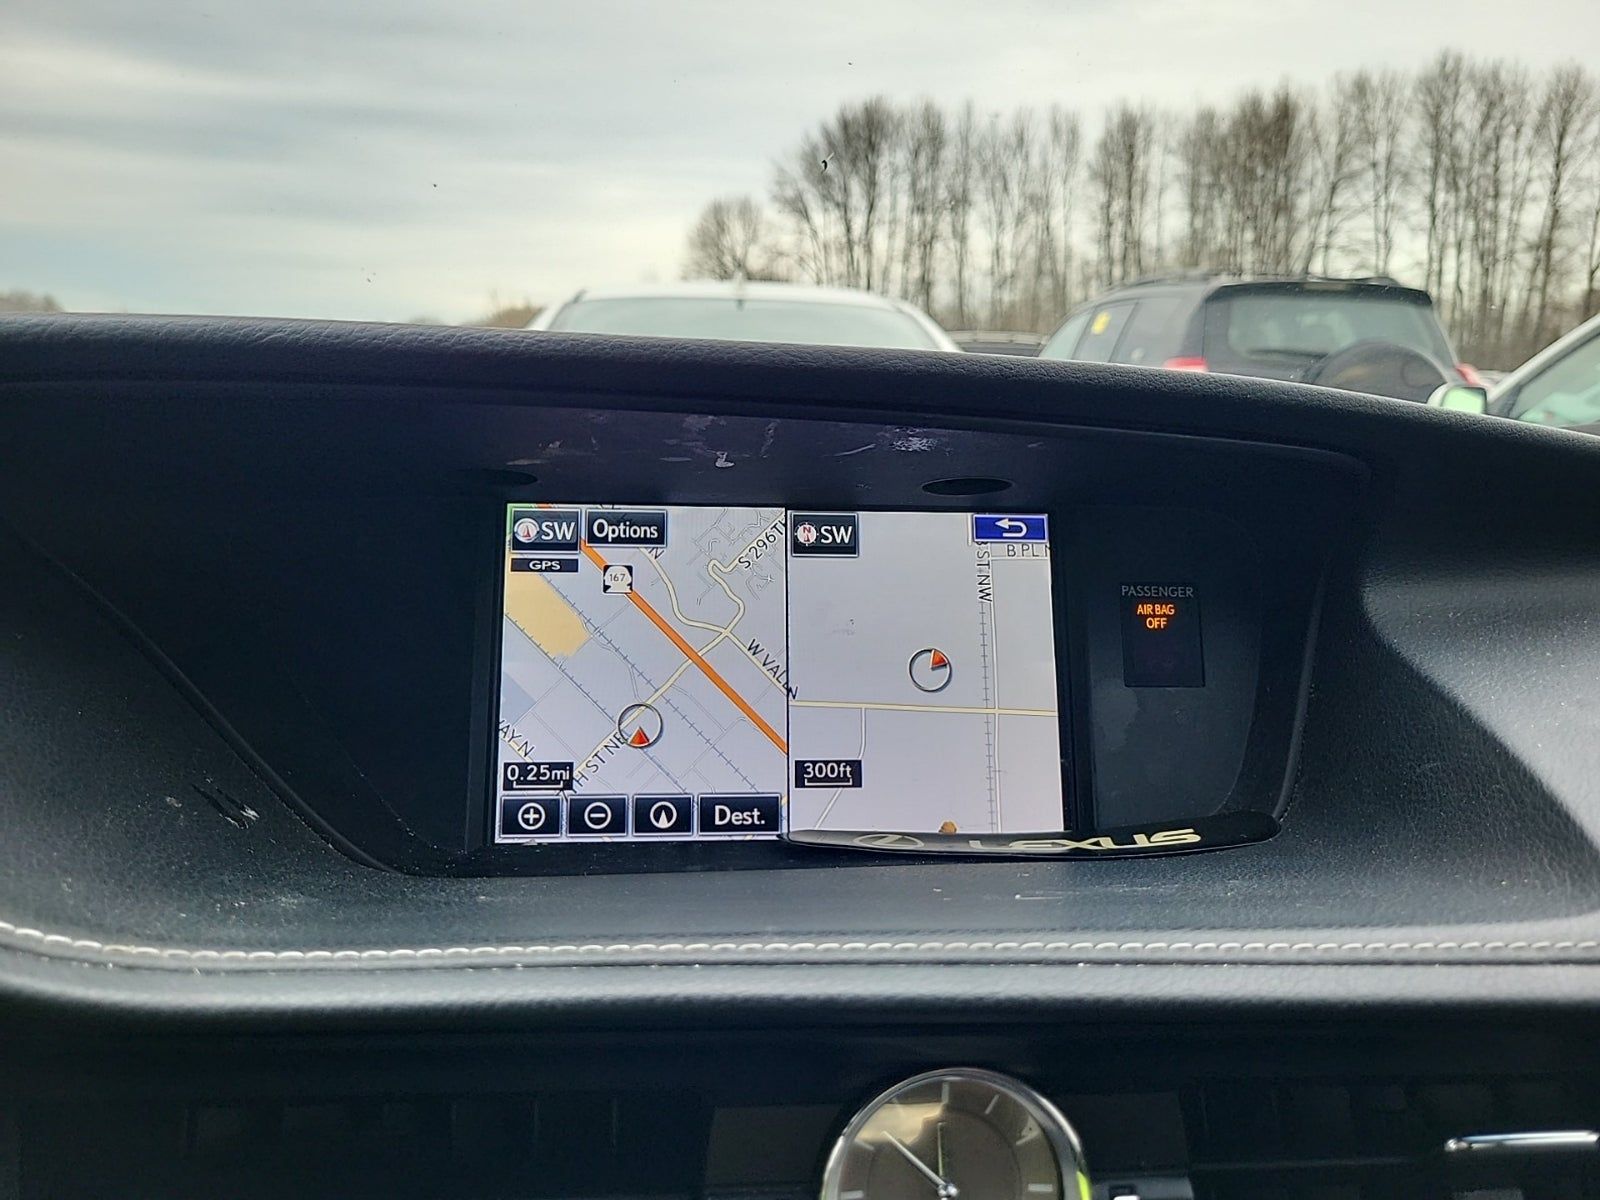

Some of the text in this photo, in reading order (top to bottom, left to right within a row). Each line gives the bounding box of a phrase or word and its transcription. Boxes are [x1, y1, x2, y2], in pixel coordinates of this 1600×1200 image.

[541, 521, 576, 541] SW
[592, 518, 658, 542] Options
[820, 525, 853, 544] SW
[529, 560, 561, 571] GPS
[609, 573, 626, 582] 167
[1121, 585, 1194, 598] PASSENGER
[1136, 604, 1175, 615] AIR BAG
[1146, 617, 1168, 629] OFF
[499, 719, 522, 743] AY
[506, 764, 570, 781] 0.25mi
[803, 762, 852, 778] 300ft
[714, 805, 766, 826] Dest.
[968, 828, 1201, 852] LEXUS
